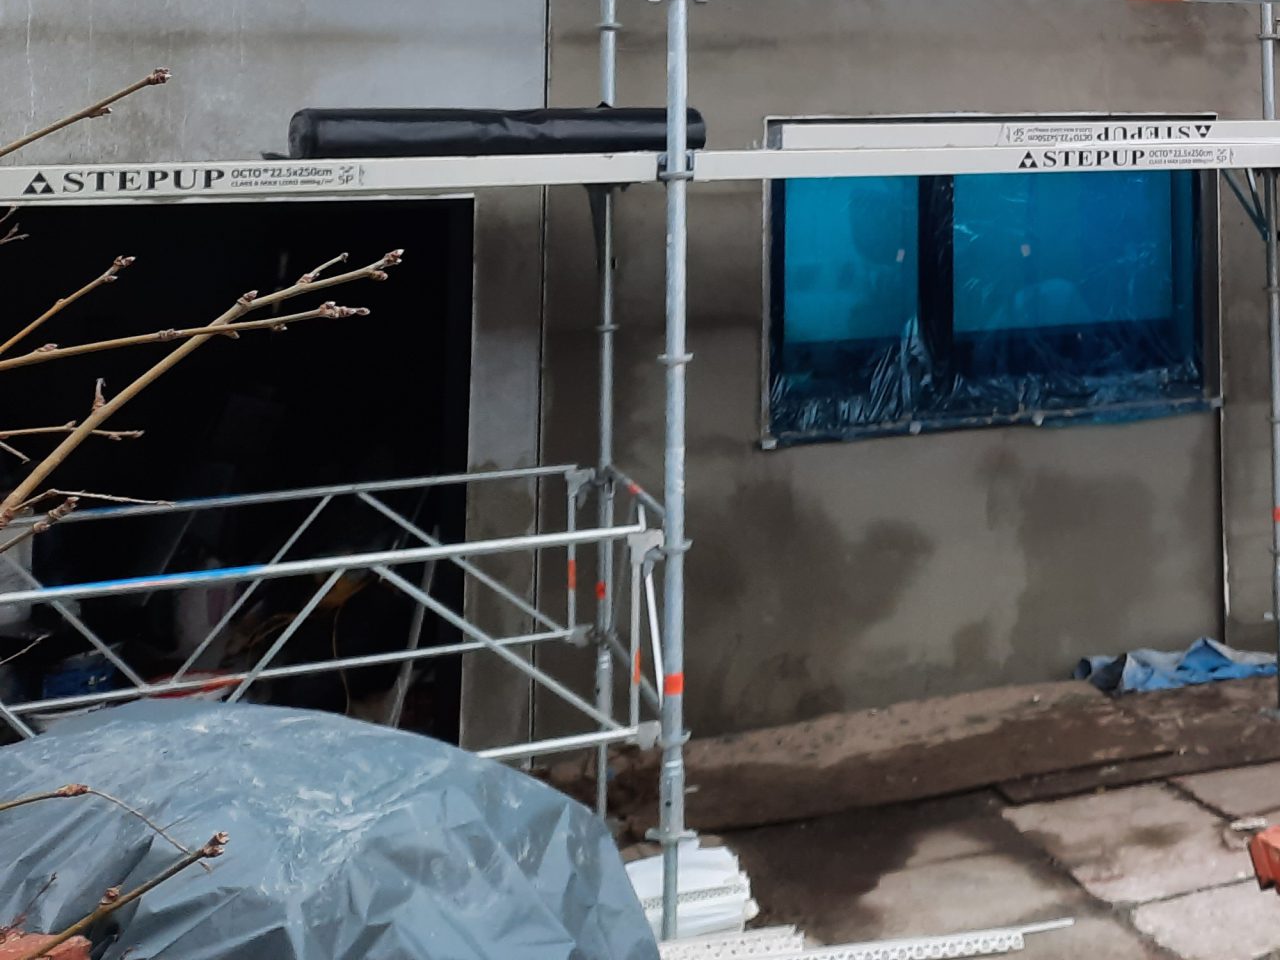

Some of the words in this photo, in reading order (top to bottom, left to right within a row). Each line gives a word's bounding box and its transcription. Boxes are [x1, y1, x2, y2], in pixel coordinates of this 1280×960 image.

[1096, 125, 1191, 141] STEPUP
[1043, 149, 1145, 168] STEPUP
[62, 168, 225, 193] STEPUP
